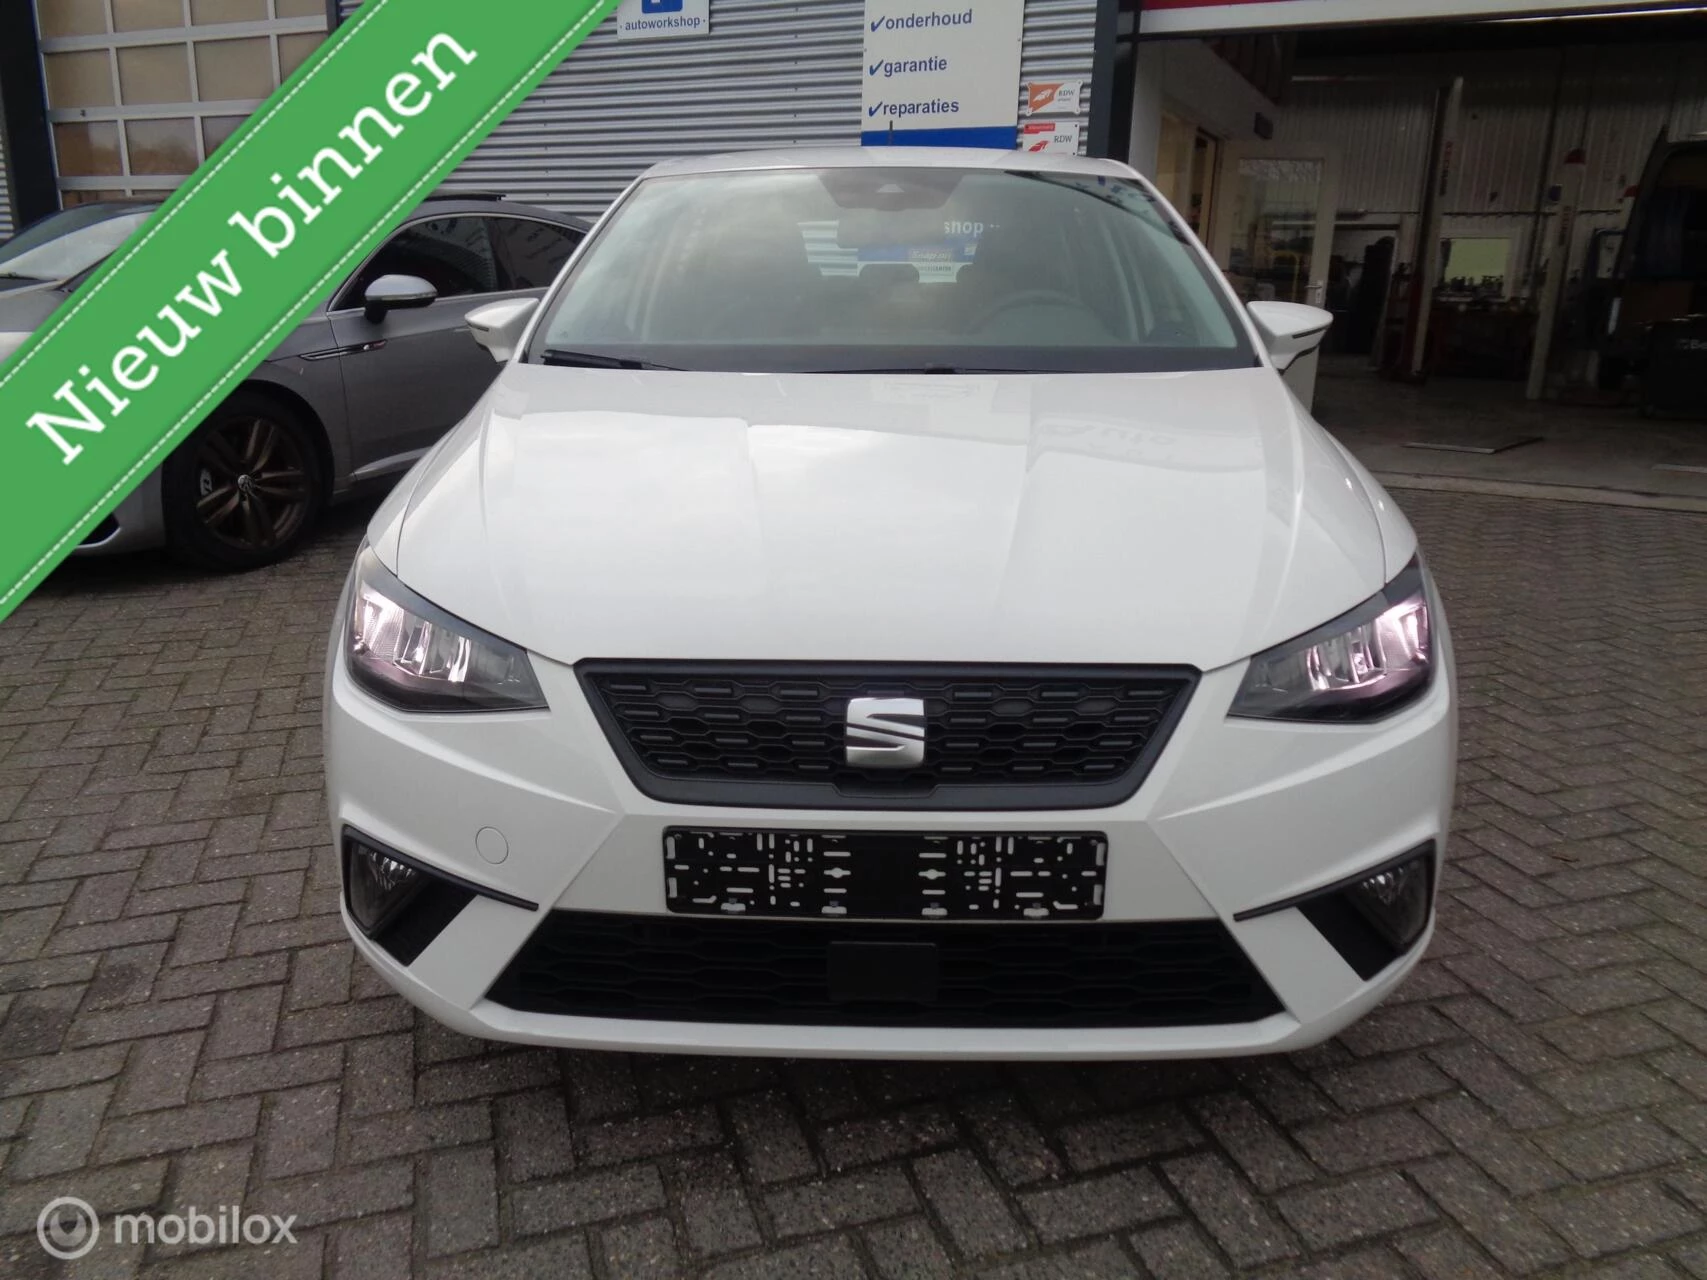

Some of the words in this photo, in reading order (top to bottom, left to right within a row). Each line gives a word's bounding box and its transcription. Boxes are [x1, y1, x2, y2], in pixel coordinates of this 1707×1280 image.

[625, 15, 701, 31] autoworkshop
[885, 8, 973, 30] onderhoud
[884, 56, 948, 78] garantie
[883, 98, 960, 118] reparaties
[1054, 135, 1073, 144] RDW
